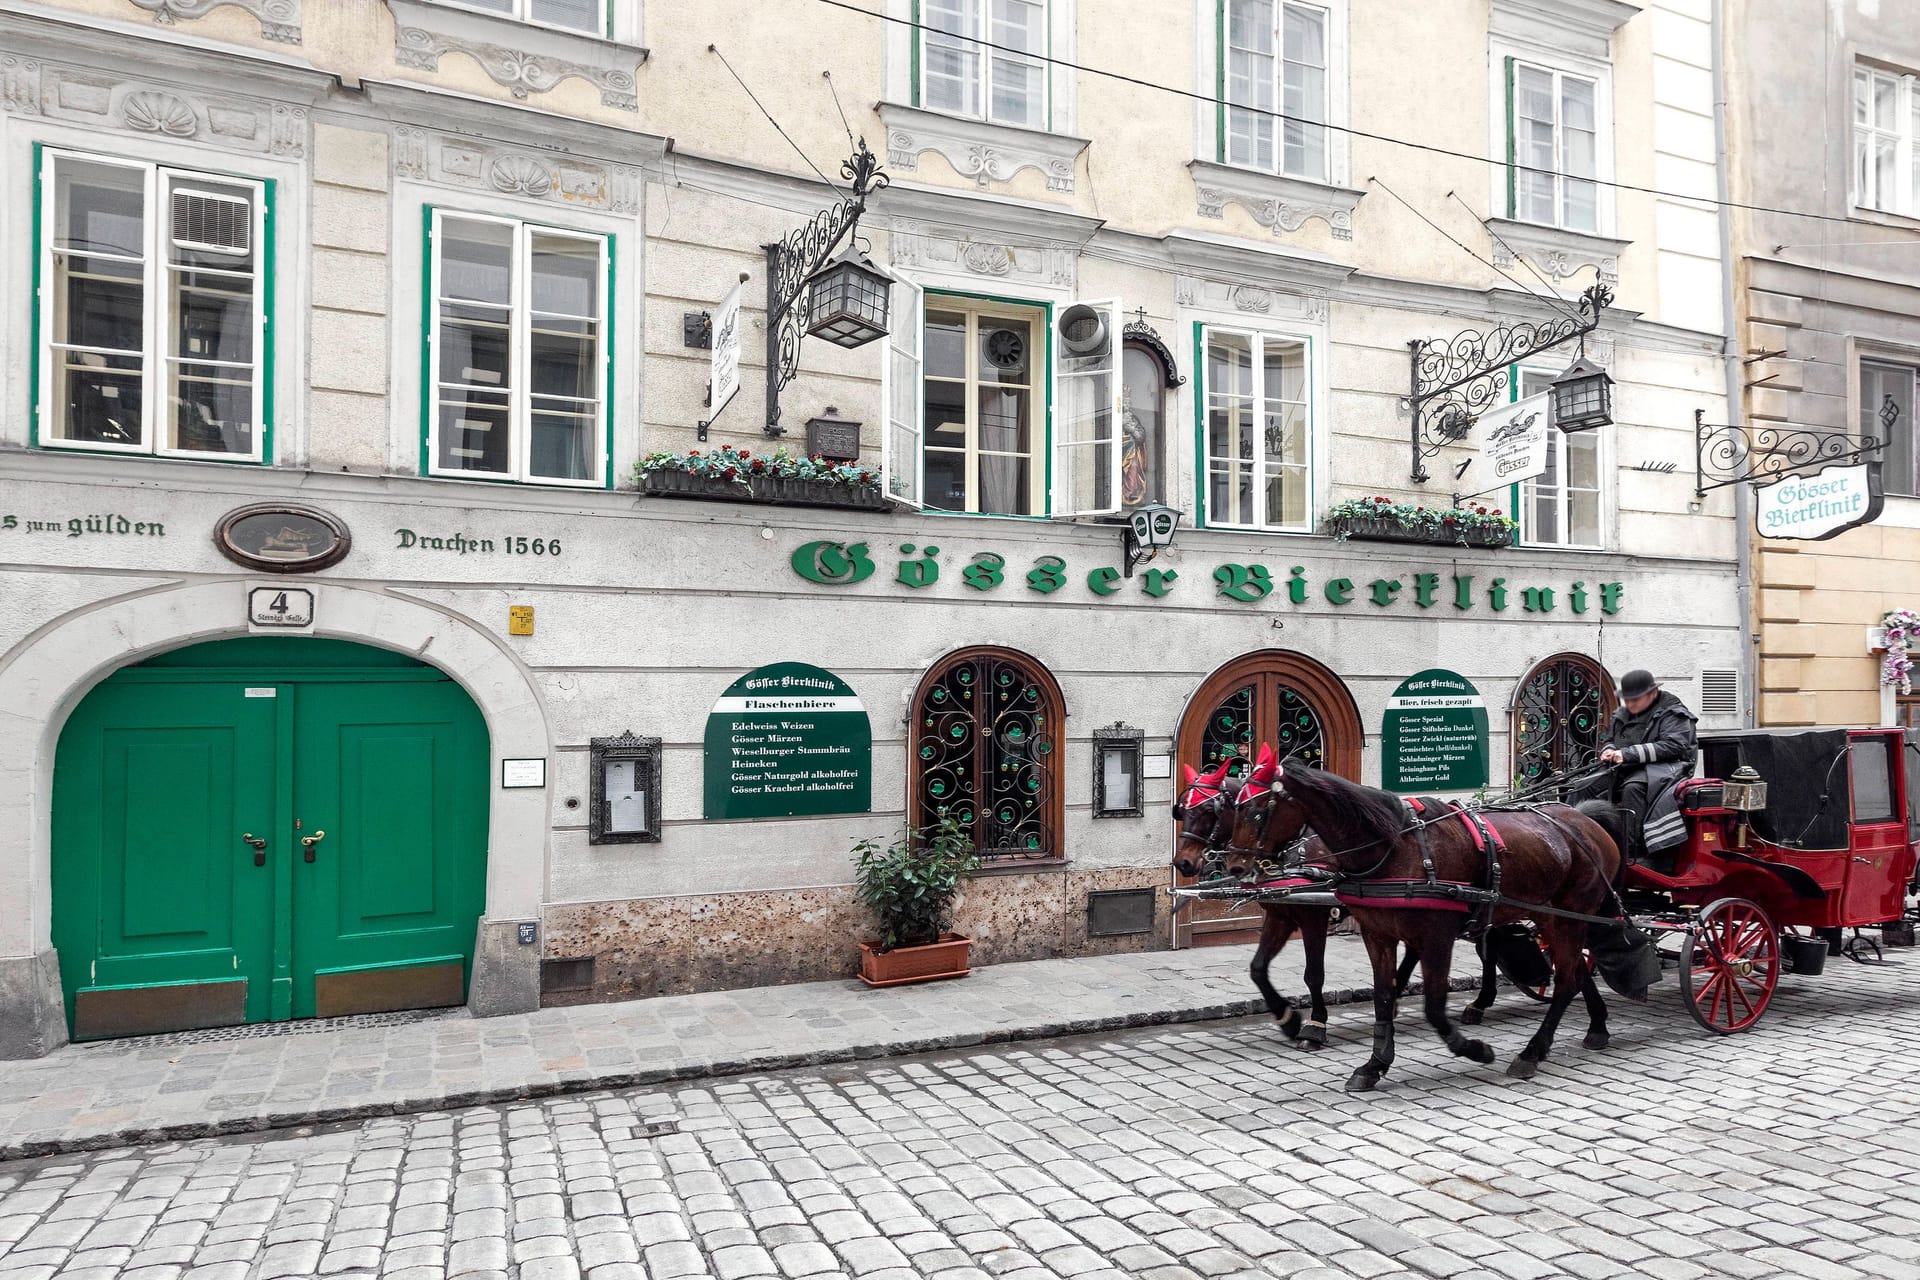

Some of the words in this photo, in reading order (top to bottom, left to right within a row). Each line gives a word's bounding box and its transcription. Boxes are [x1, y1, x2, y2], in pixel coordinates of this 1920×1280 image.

[1495, 456, 1531, 478] Gösser
[1777, 478, 1849, 504] Gösser
[1765, 492, 1862, 528] Bierklinik
[26, 520, 62, 534] zum
[67, 513, 165, 538] gülden
[394, 528, 495, 556] Drachen
[504, 536, 562, 556] 1566
[790, 540, 1180, 599] Gösser
[1213, 563, 1626, 616] Bierklinik
[270, 592, 288, 613] 4
[745, 679, 780, 690] Gösser
[781, 675, 835, 691] Bierklinik
[745, 699, 836, 709] Flaschenbiere
[1422, 715, 1444, 723] Spezial
[731, 722, 778, 731] Edelweiss
[780, 721, 814, 730] Weizen
[731, 734, 765, 743] Gösser
[767, 734, 802, 743] Märzen
[731, 747, 795, 757] Wieselburger
[797, 746, 851, 755] Stammbräu
[1436, 744, 1473, 752] (hell/dunkel)
[731, 760, 778, 768] Heineken
[1399, 755, 1442, 763] Schladminger
[1399, 765, 1438, 773] Reininghaus
[731, 773, 762, 782] Gösser
[764, 772, 809, 781] Naturgold
[811, 769, 859, 779] alkoholfrei
[1399, 775, 1434, 783] Altbrünner
[1435, 773, 1450, 781] Gold
[731, 785, 762, 795] Gösser
[764, 783, 804, 793] Kracherl
[806, 781, 854, 792] alkoholfrei
